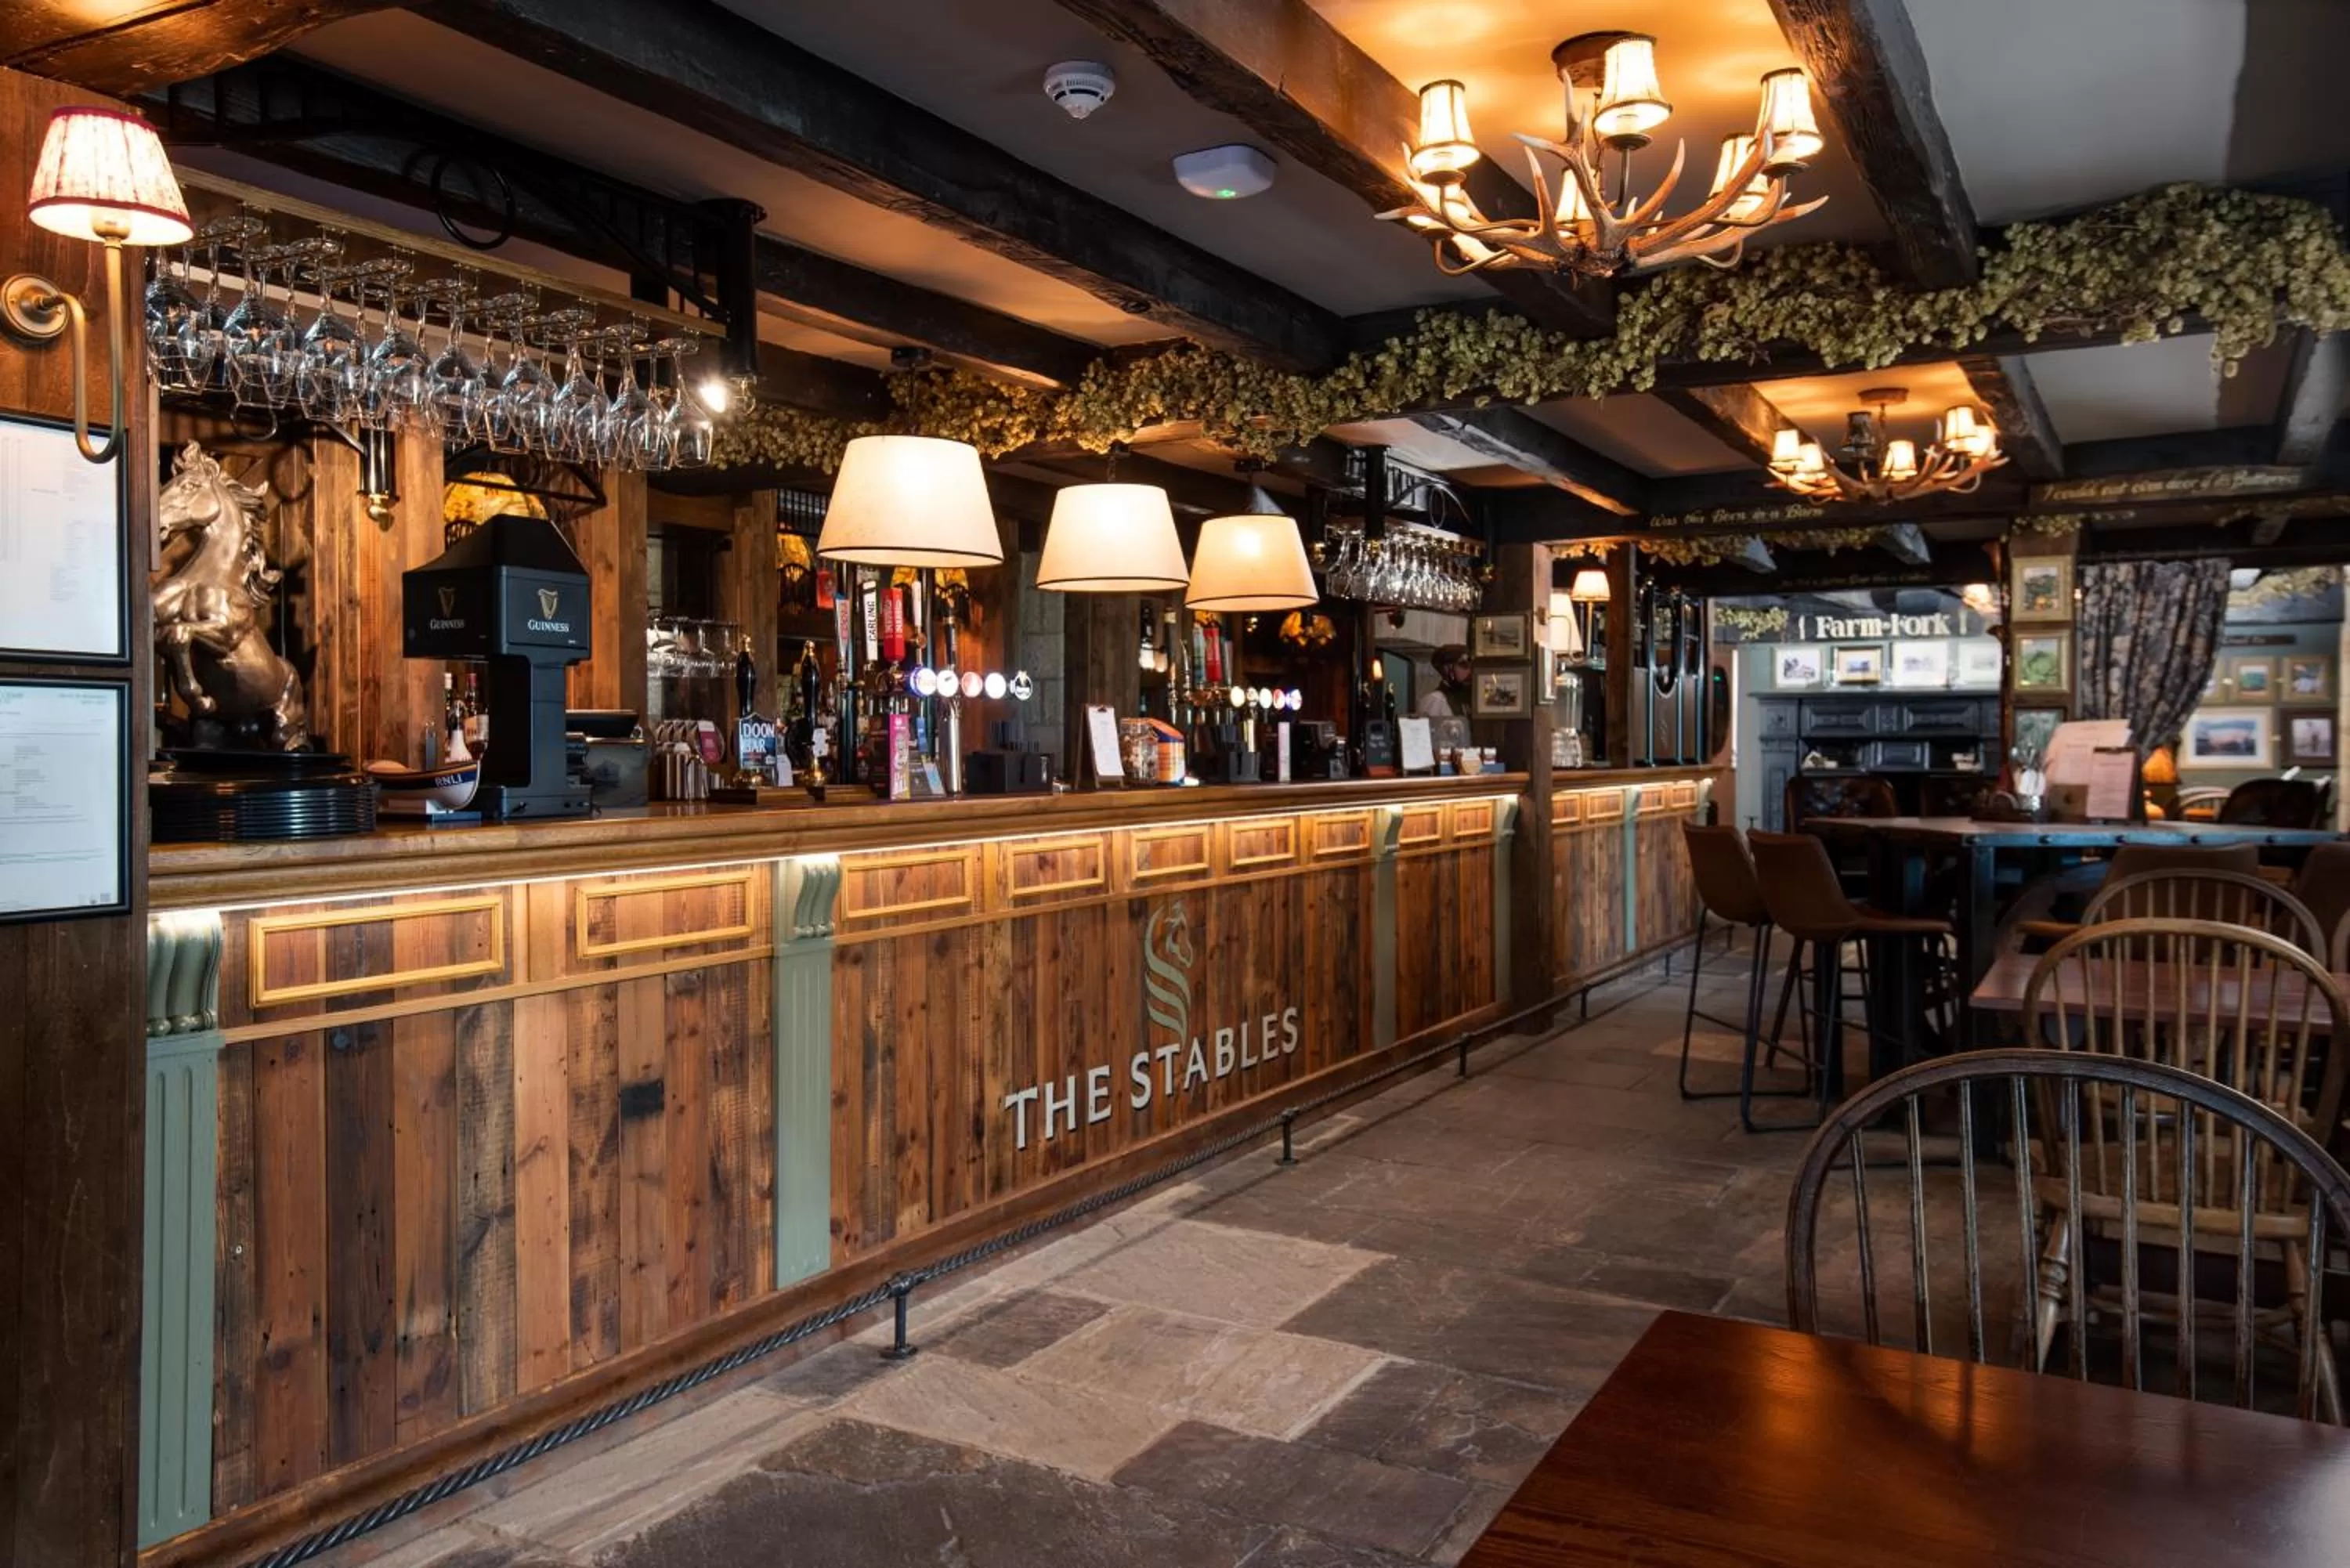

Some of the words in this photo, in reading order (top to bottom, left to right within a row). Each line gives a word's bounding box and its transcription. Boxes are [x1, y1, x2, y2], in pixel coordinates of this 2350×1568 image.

[527, 619, 570, 633] GUINNESS
[866, 601, 877, 641] CARLING
[742, 723, 776, 738] DOON
[1004, 1064, 1112, 1150] THE
[1130, 1006, 1299, 1110] STABLES
